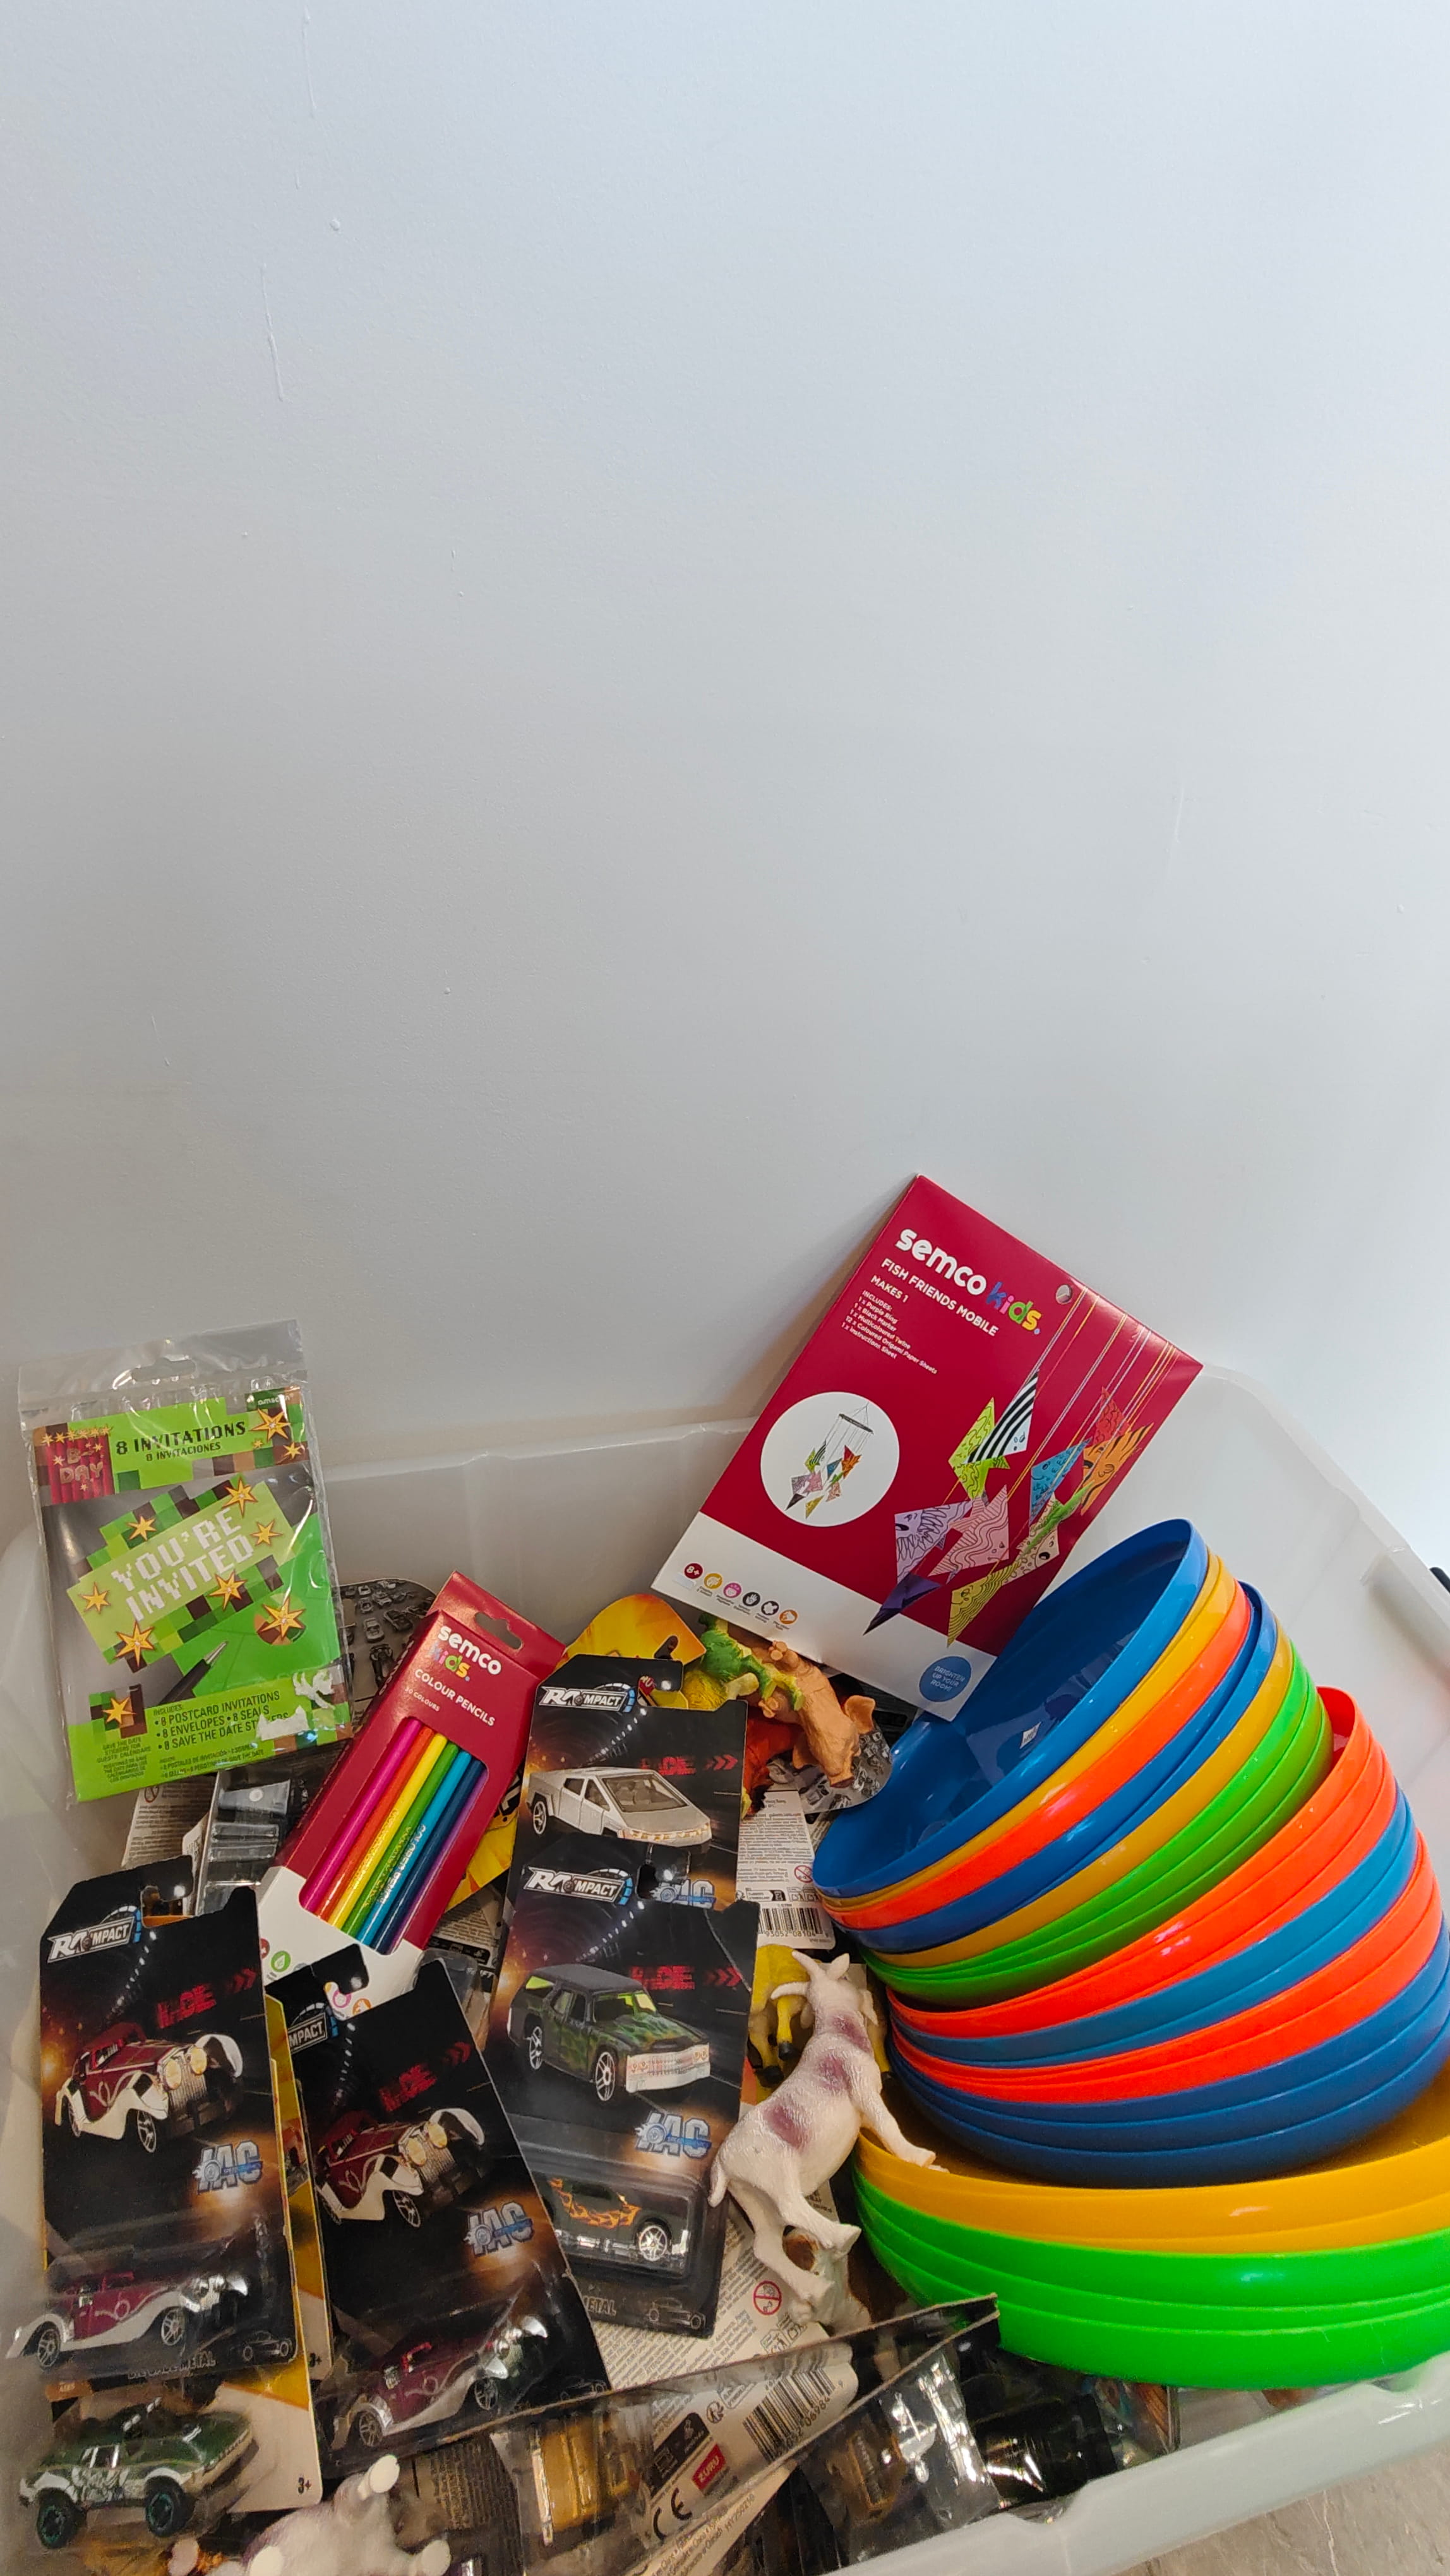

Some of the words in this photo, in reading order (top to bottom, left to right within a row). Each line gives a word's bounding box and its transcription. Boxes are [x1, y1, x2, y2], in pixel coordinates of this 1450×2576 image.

[896, 1229, 986, 1295] semco
[862, 1290, 892, 1311] INCLUDES:
[871, 1275, 902, 1299] MAKES
[903, 1294, 909, 1303] 1
[881, 1258, 909, 1280] FISH
[909, 1275, 957, 1310] FRIENDS
[956, 1305, 999, 1337] MOBILE
[862, 1308, 878, 1320] Black
[877, 1318, 896, 1332] Marker
[866, 1301, 884, 1315] Purple
[884, 1312, 899, 1324] Ring
[849, 1327, 881, 1349] Instructions
[881, 1346, 897, 1359] Sheet
[858, 1313, 895, 1339] Multicoloured
[895, 1336, 911, 1349] Twine
[857, 1323, 882, 1340] Coloured
[882, 1338, 904, 1354] Origami
[903, 1350, 919, 1363] Paper
[919, 1360, 937, 1374] Sheets
[258, 1395, 291, 1405] amscn
[116, 1440, 128, 1455] 8
[133, 1421, 246, 1453] INVITATIONS
[145, 1453, 152, 1462] 8
[156, 1441, 221, 1460] INVITACIONES
[60, 1461, 104, 1484] DAY
[111, 1507, 241, 1591] YOU'RE
[126, 1535, 254, 1621] INVITED
[686, 1566, 700, 1576] 8+
[438, 1626, 501, 1675] semco
[935, 1666, 966, 1682] BRIGHTEN
[942, 1676, 959, 1687] YOUR
[161, 1717, 167, 1726] 8
[169, 1704, 219, 1725] POSTCARD
[222, 1690, 280, 1712] INVITATIONS
[413, 1691, 440, 1712] COLOURS
[415, 1669, 456, 1700] COLOUR
[455, 1695, 496, 1726] PENCILS
[162, 1729, 168, 1738] 8
[171, 1717, 225, 1737] ENVELOPES
[233, 1712, 239, 1722] 8
[164, 1741, 170, 1750] 8
[172, 1732, 198, 1748] SAVE
[200, 1728, 217, 1743] THE
[219, 1723, 243, 1737] DATE
[289, 2020, 323, 2047] MPACT
[697, 2455, 720, 2483] ZURU
[297, 2477, 312, 2495] 3+
